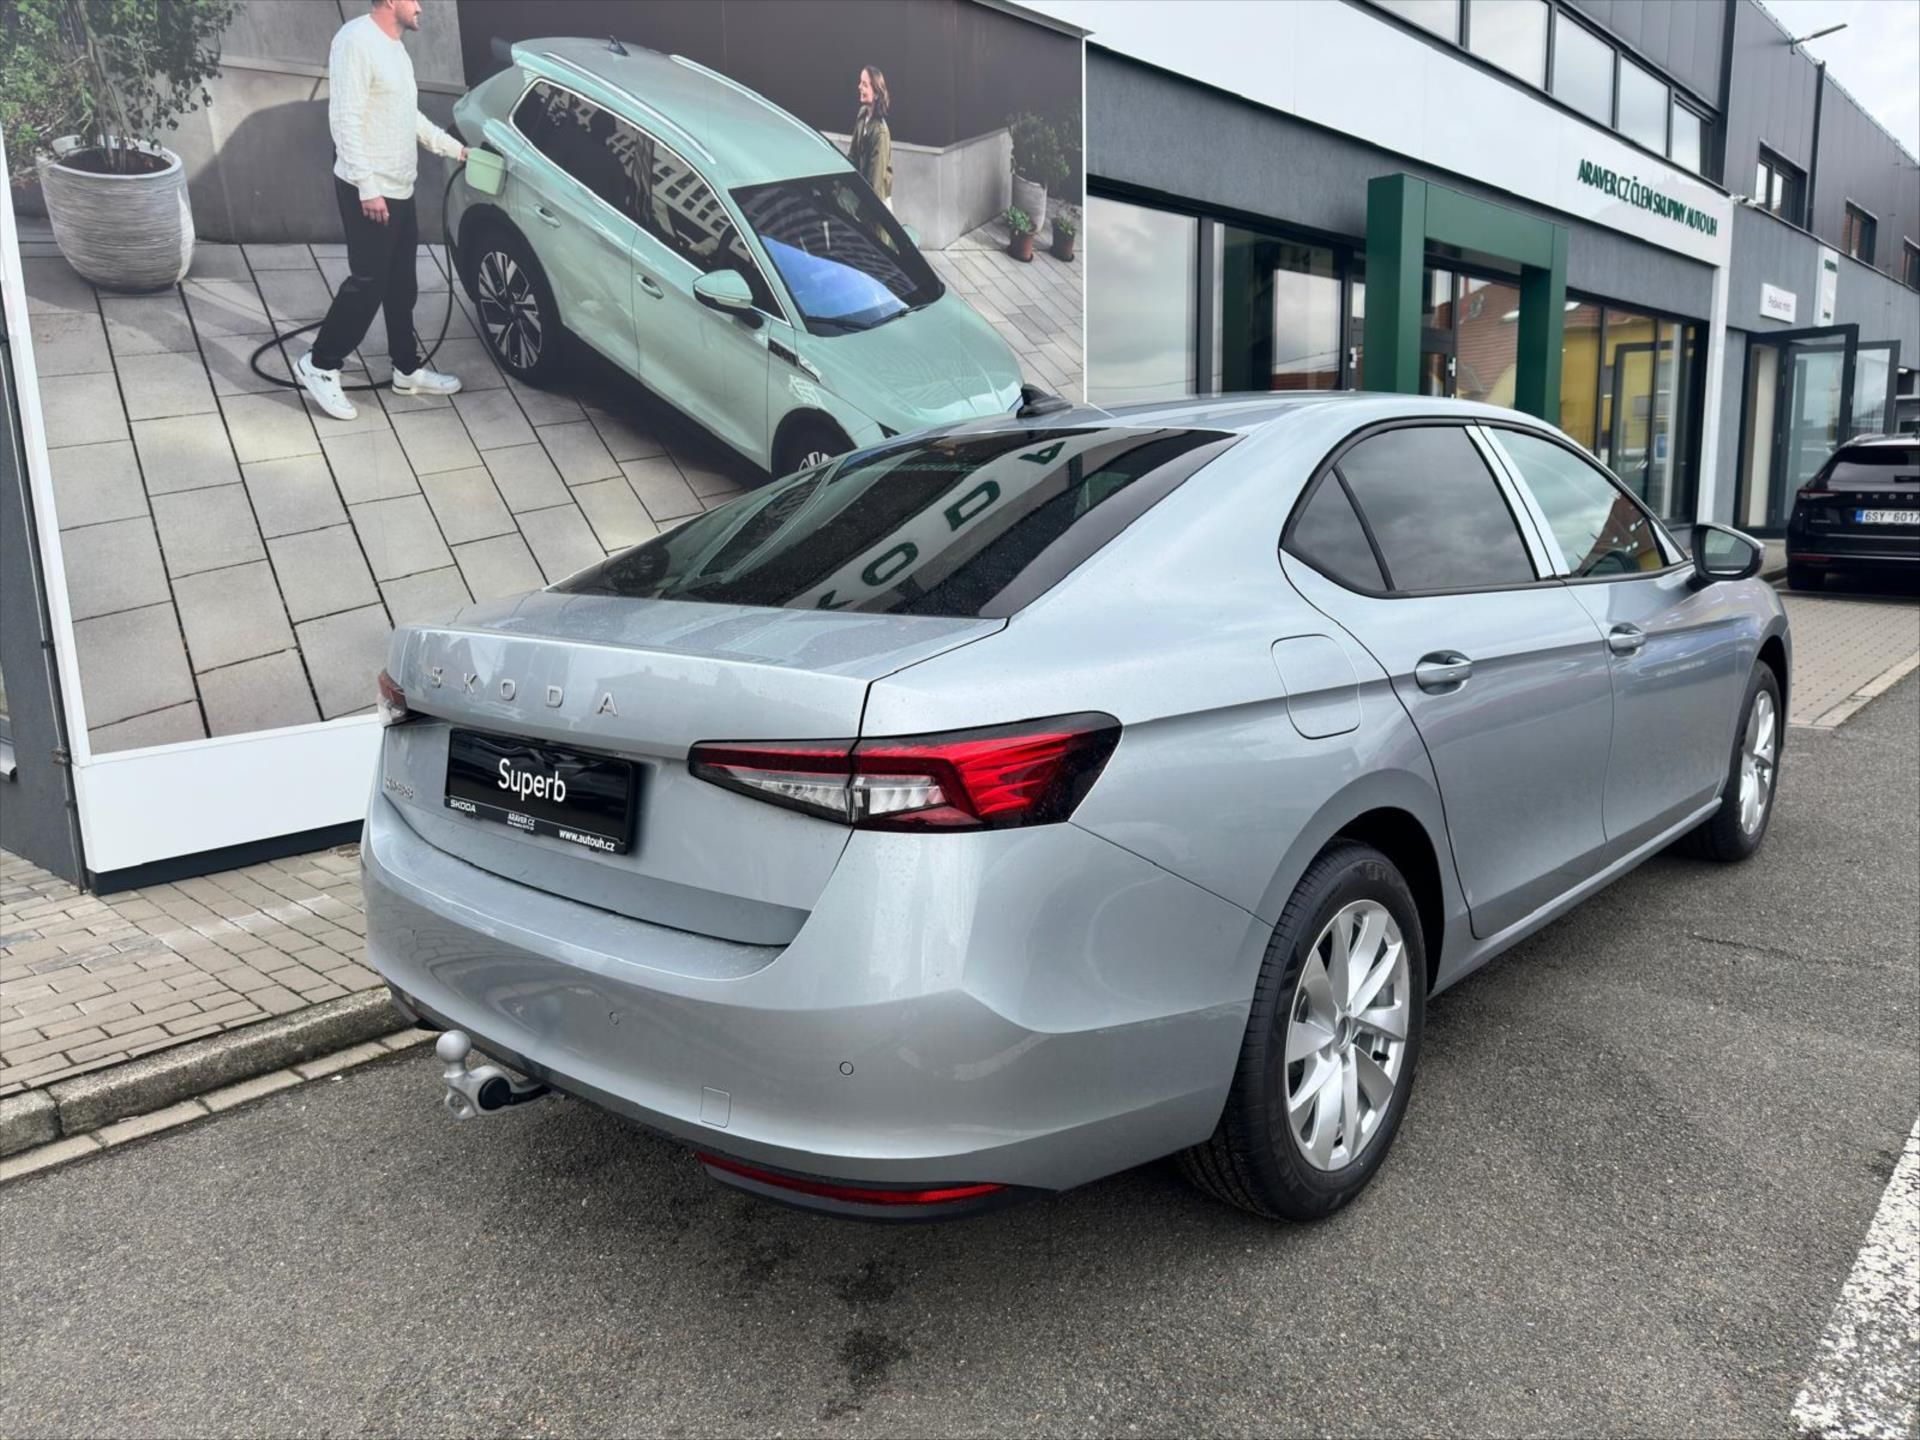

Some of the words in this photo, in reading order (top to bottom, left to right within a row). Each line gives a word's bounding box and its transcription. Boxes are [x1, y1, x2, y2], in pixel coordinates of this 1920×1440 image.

[1577, 158, 1617, 196] ARAVER
[1617, 176, 1631, 202] CZ
[1630, 175, 1653, 211] ČLEN
[1653, 192, 1687, 223] SKUPINY
[1865, 511, 1886, 521] 6SY
[498, 758, 566, 802] Superb
[559, 829, 615, 852] www.autouh.cz
